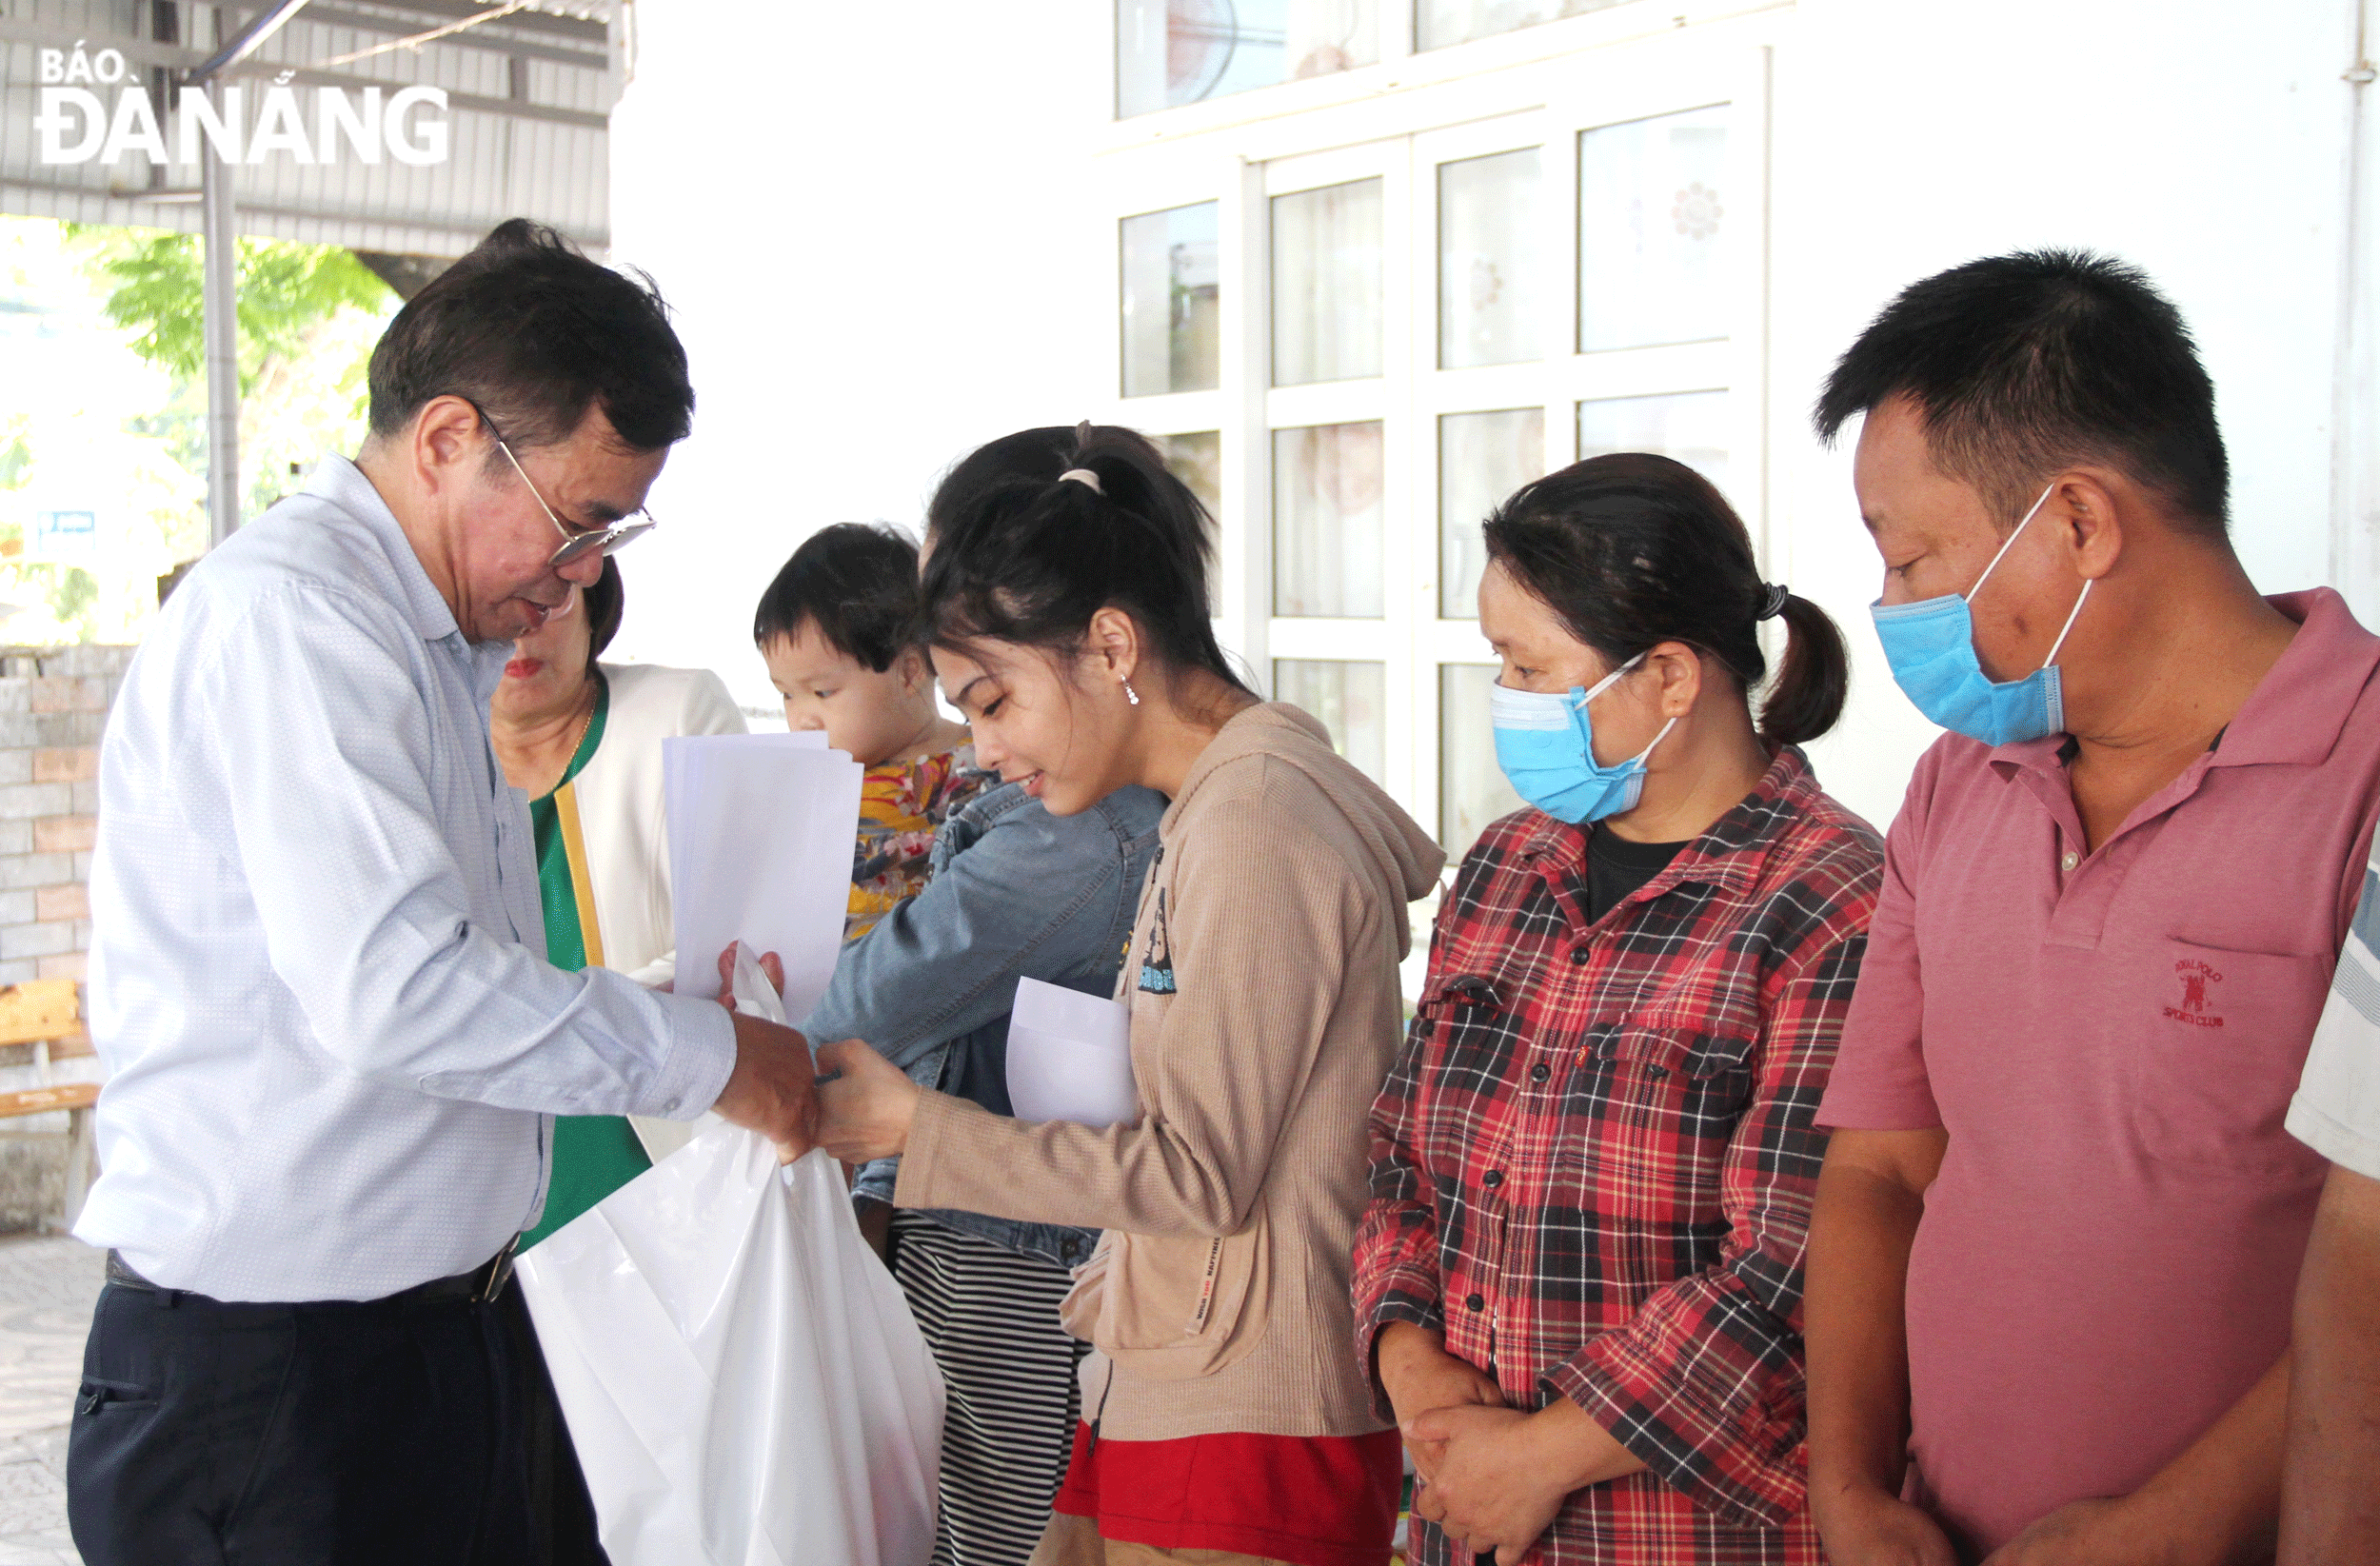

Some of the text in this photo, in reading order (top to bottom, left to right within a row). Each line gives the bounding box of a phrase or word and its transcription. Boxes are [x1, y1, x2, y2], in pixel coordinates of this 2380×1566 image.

[2197, 961, 2223, 982] POLO
[2163, 1006, 2224, 1028] SPORTS CLUB
[1197, 1298, 1206, 1319] WISH
